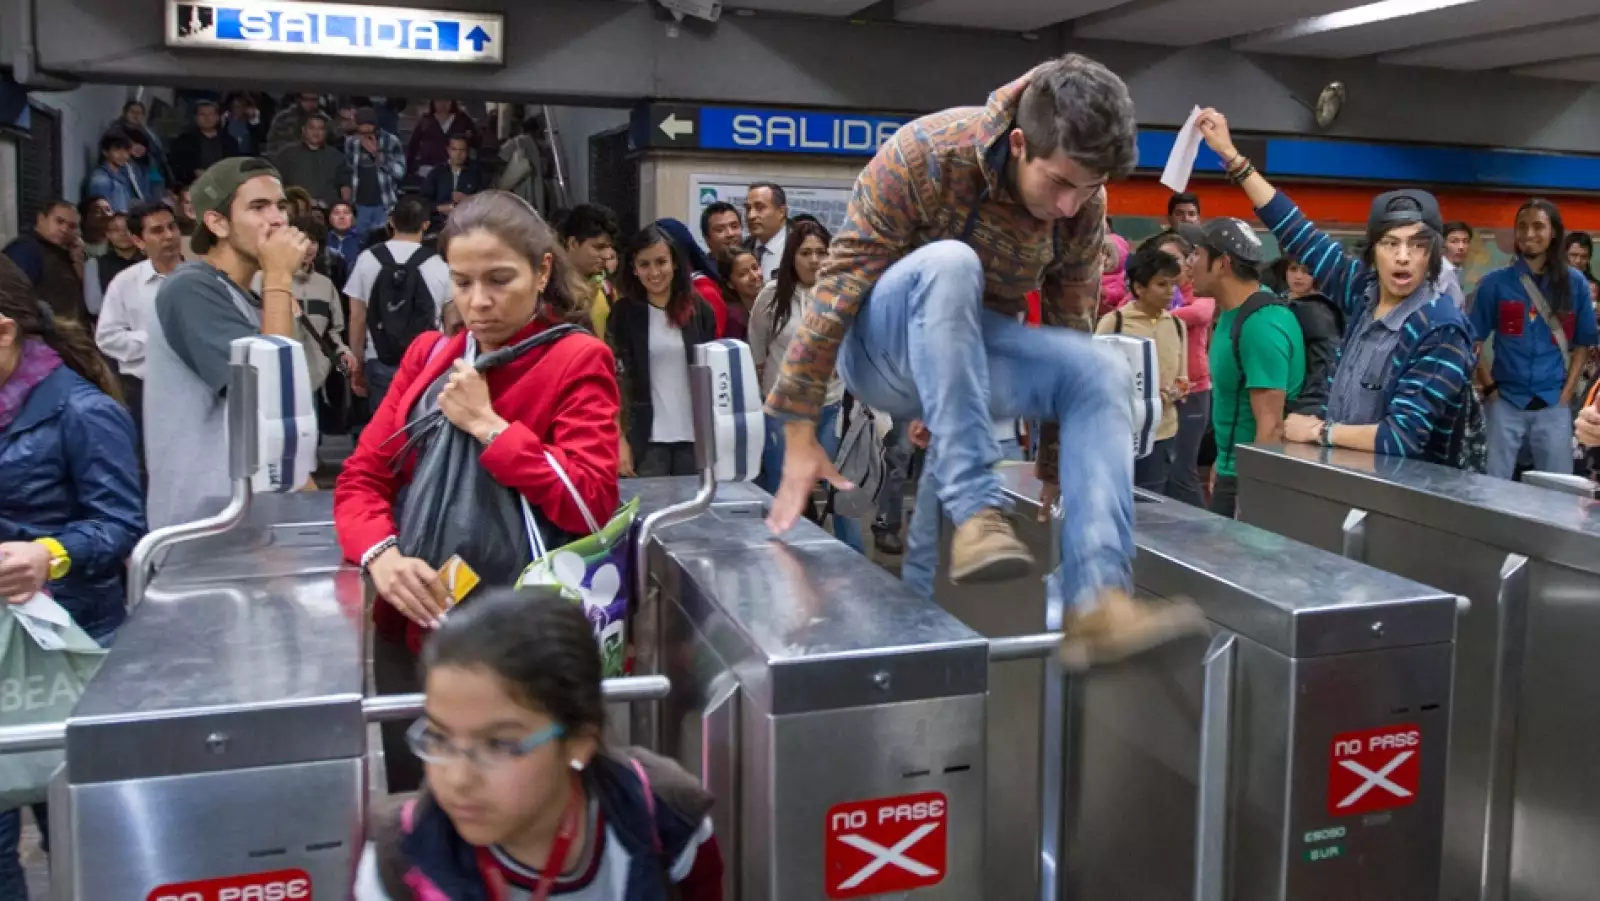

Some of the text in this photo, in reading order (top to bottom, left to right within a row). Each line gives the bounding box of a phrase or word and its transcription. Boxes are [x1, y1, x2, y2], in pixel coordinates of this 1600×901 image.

[239, 7, 439, 52] SALIDA
[1335, 730, 1420, 756] NO PASE
[832, 800, 944, 831] NO PASE
